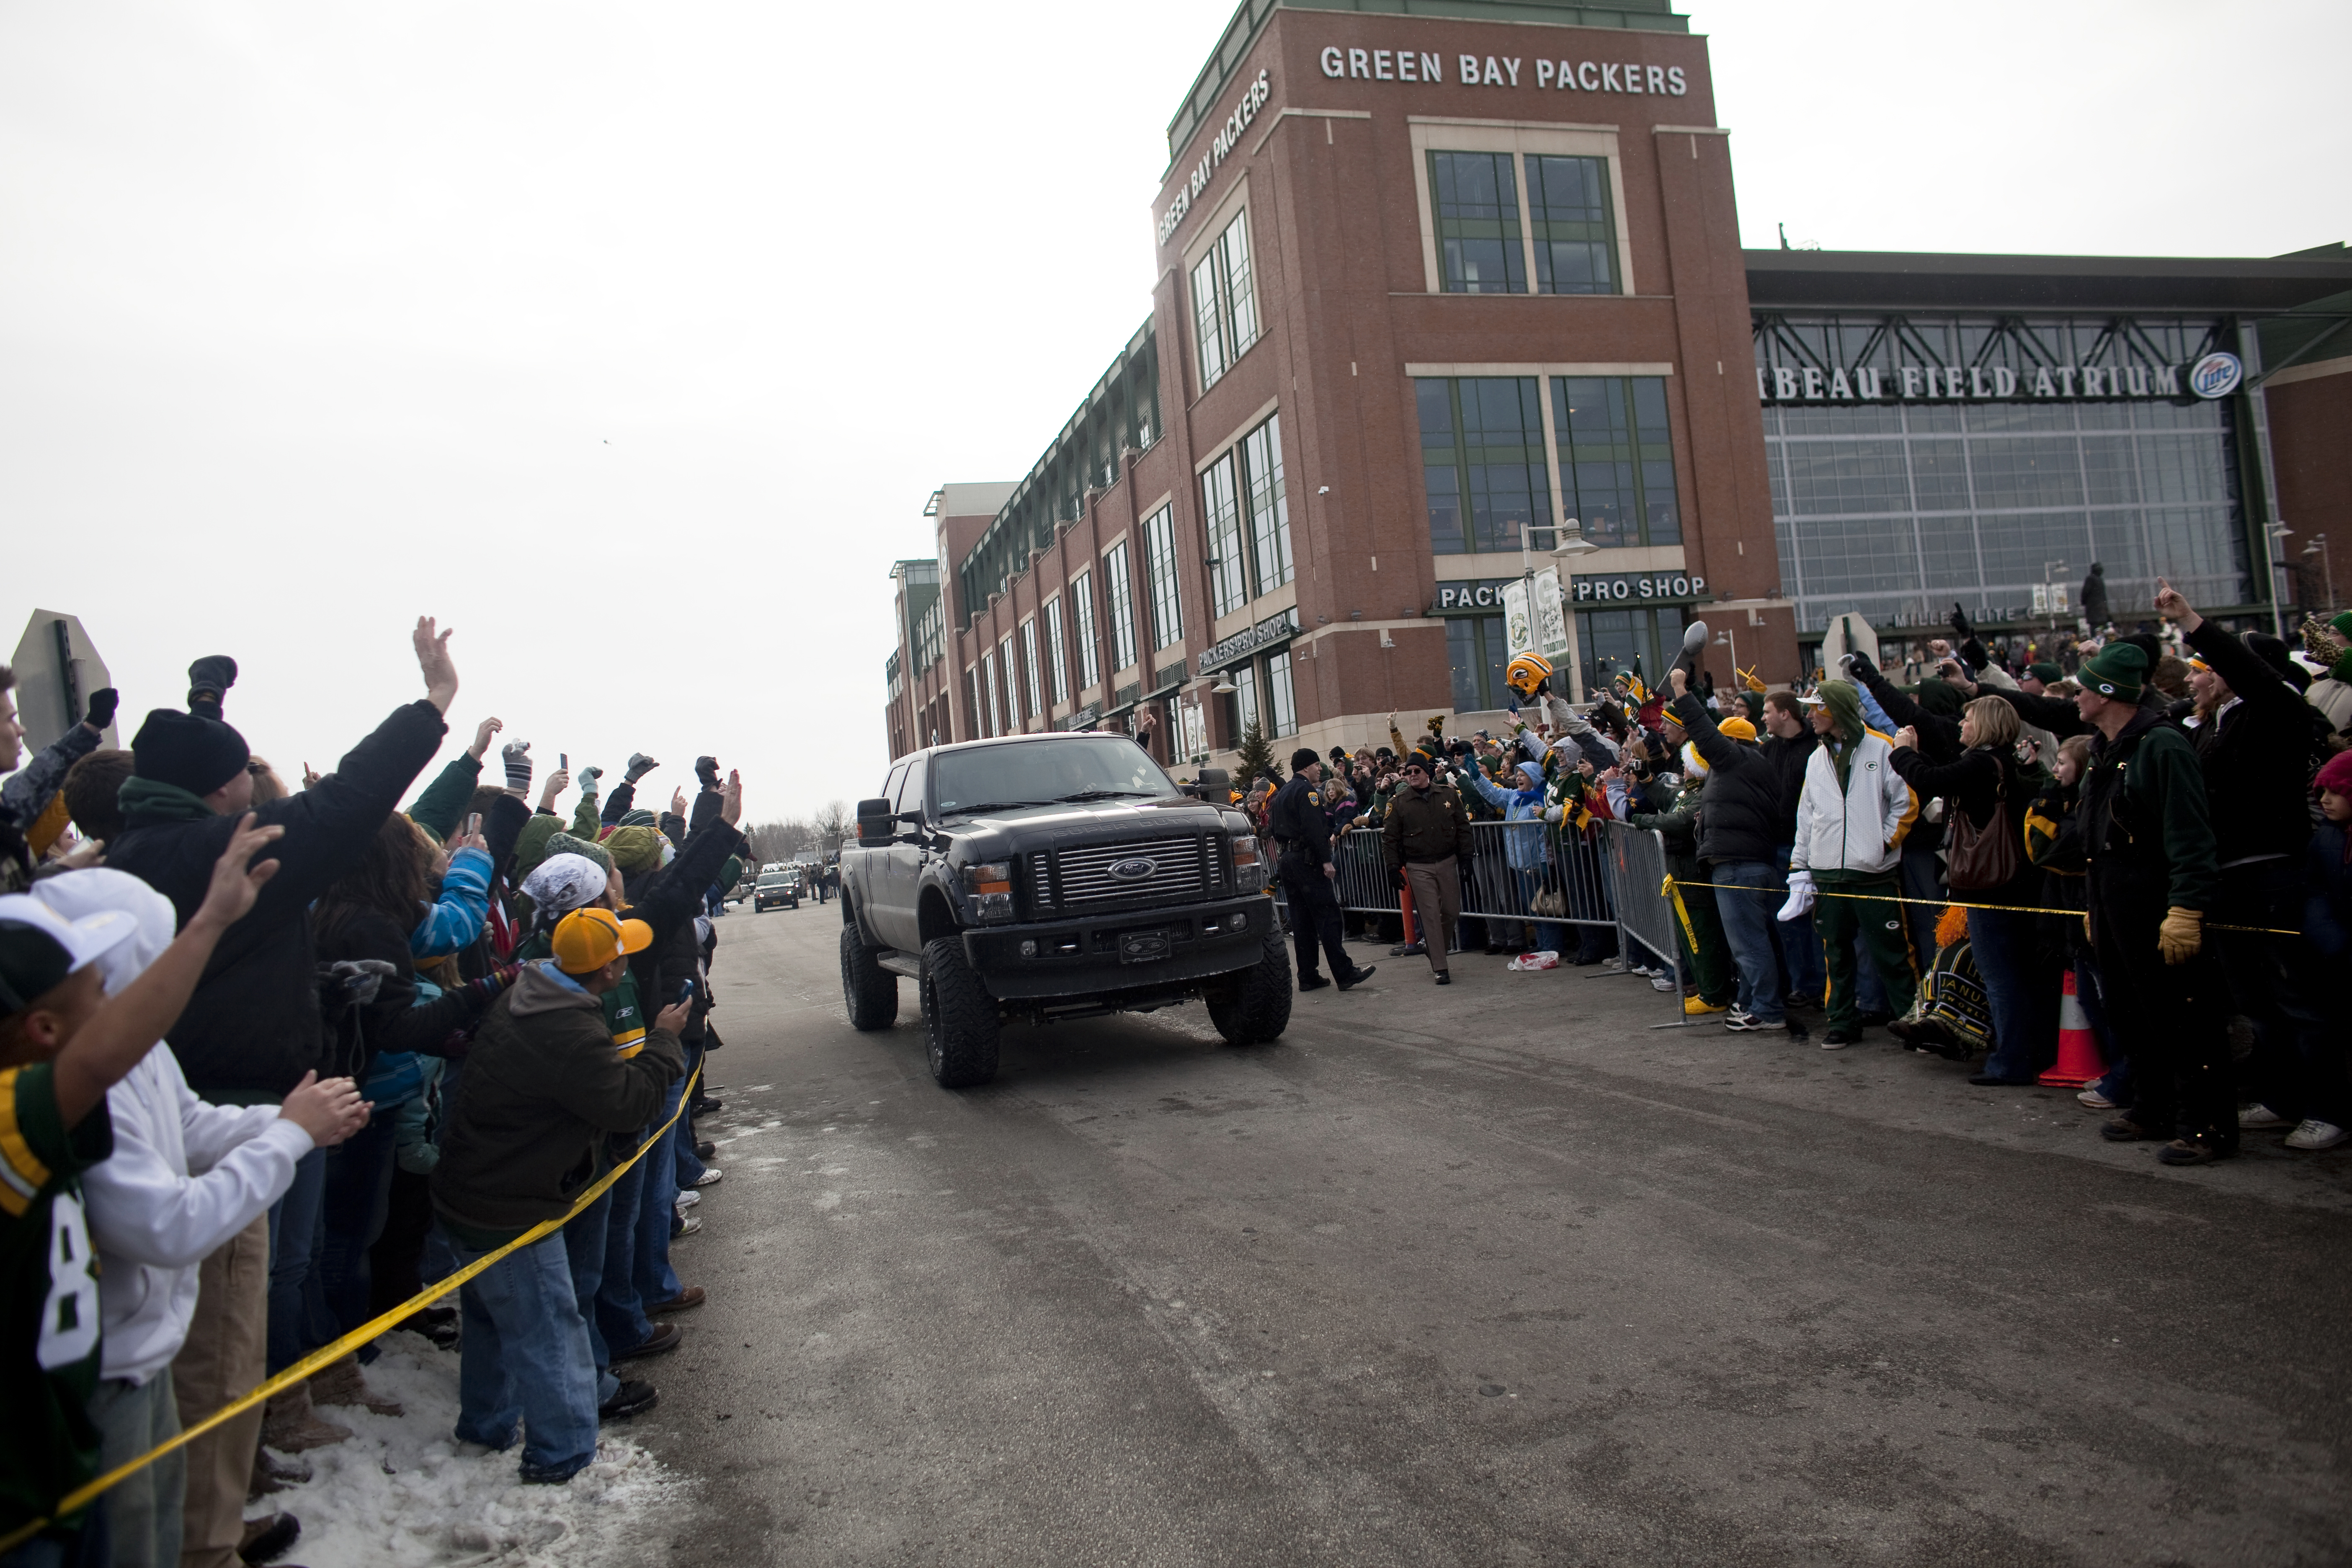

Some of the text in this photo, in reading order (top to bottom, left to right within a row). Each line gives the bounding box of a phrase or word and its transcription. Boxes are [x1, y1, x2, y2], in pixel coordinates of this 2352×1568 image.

[1320, 46, 1687, 96] GREEN BAY PACKERS
[1158, 68, 1270, 247] GREEN BAY PACKERS
[1901, 366, 2017, 398] FIELD
[2034, 366, 2180, 397] ATRIUM
[1578, 580, 1629, 601] PRO
[1638, 576, 1705, 598] SHOP
[1893, 609, 1952, 628] MILLE
[1974, 607, 2016, 623] LITE
[1198, 615, 1284, 669] PACKERS PRO SHOP
[1543, 638, 1567, 655] TRADITION
[1053, 816, 1193, 837] SUPER DUTY
[1124, 864, 1144, 874] Ford
